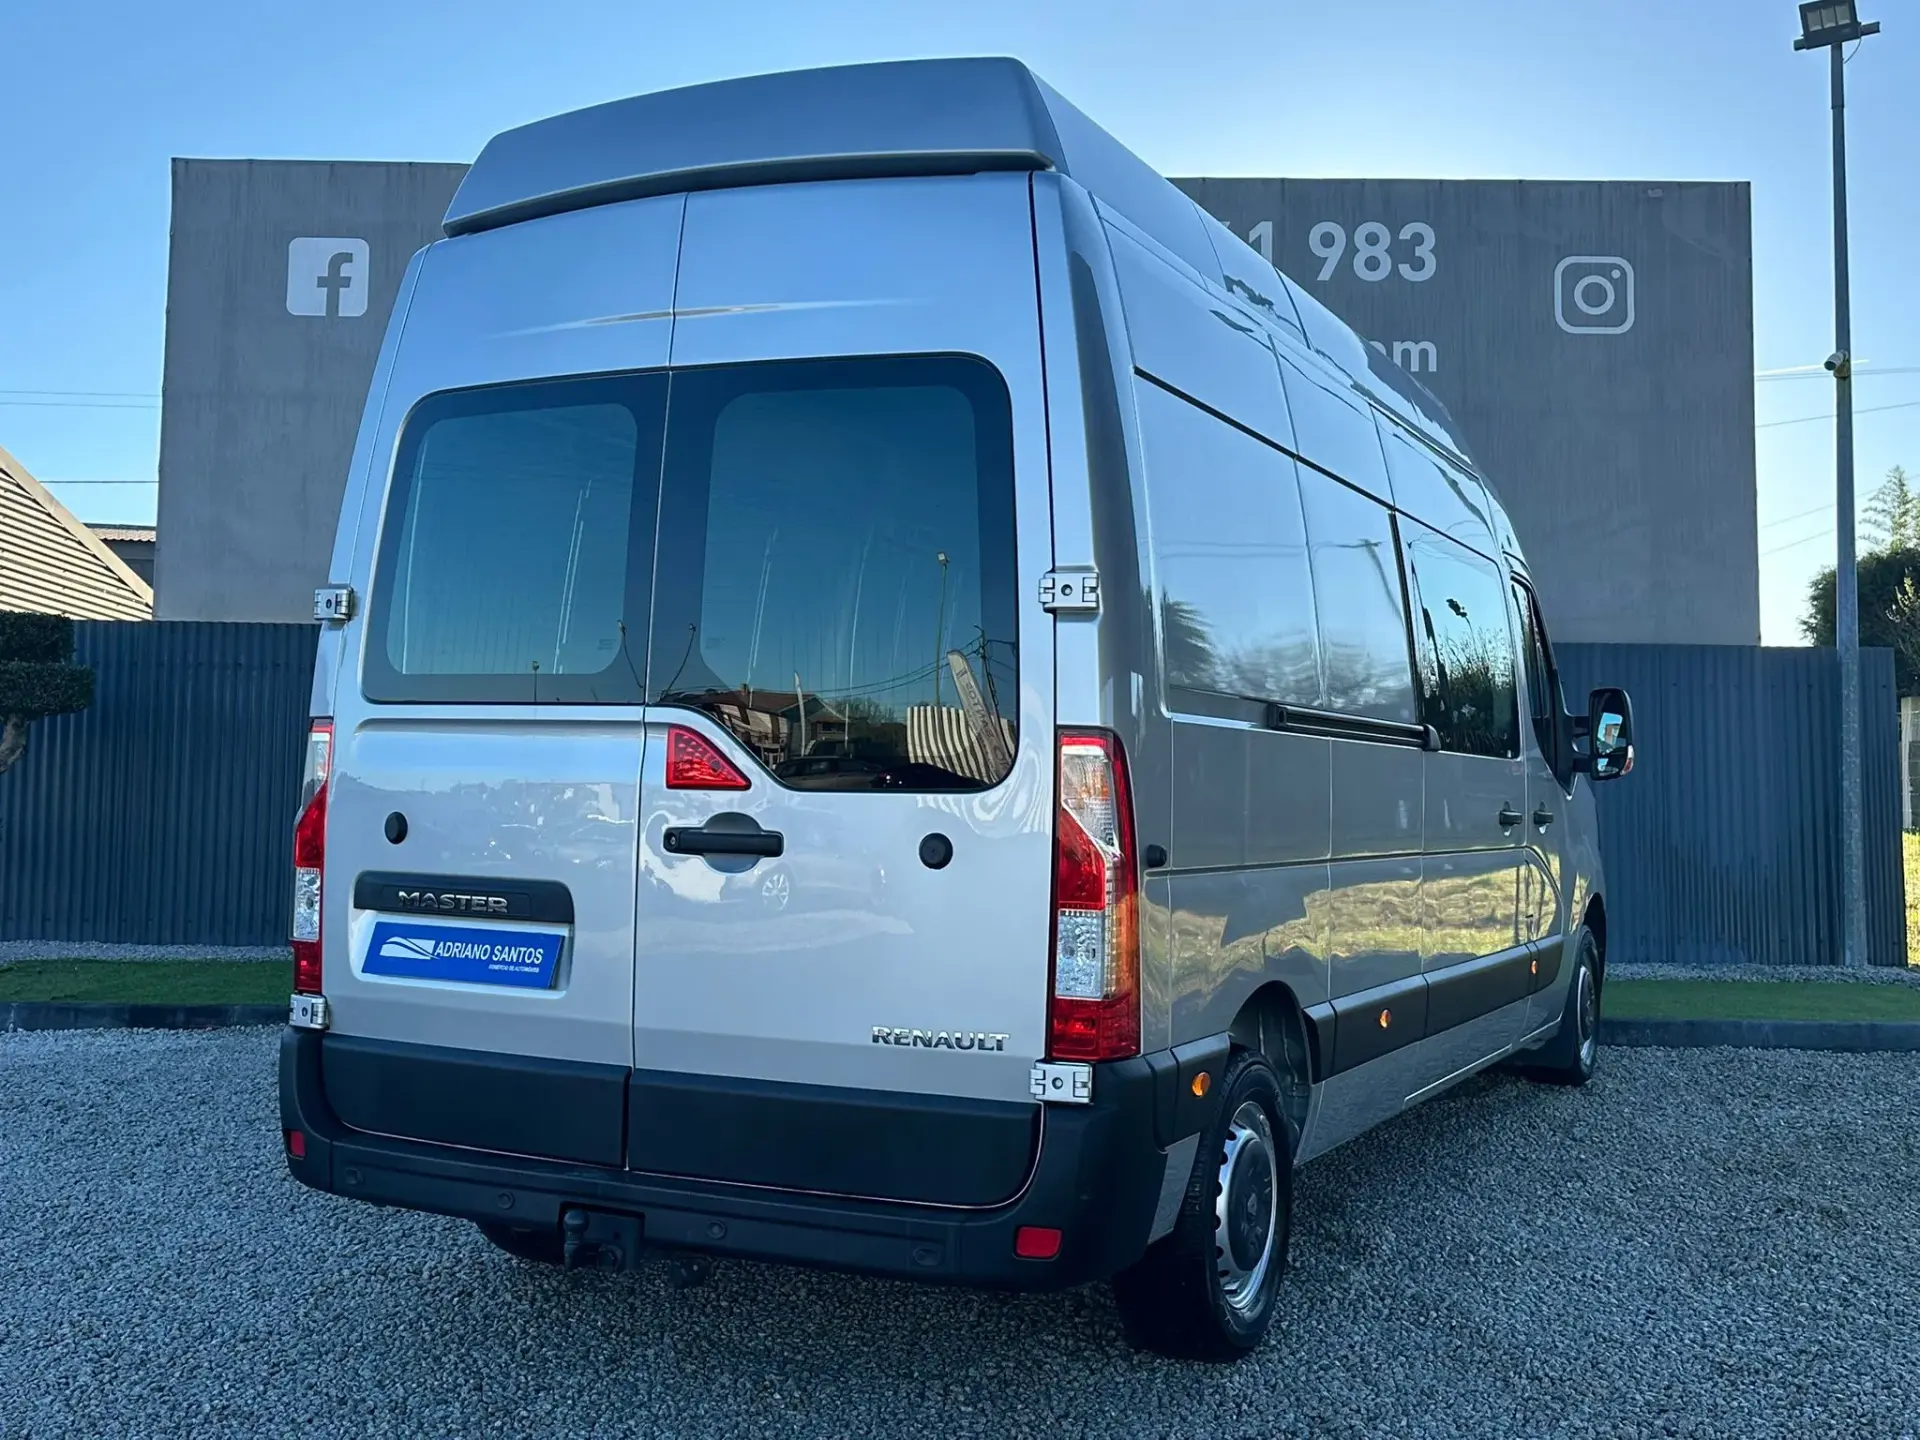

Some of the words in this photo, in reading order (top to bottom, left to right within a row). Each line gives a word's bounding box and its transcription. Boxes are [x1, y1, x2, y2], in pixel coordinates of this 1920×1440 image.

[1308, 221, 1437, 282] 983
[1369, 341, 1437, 372] m
[398, 890, 508, 913] MASTER
[434, 941, 491, 960] ADRIANO
[492, 946, 544, 964] SANTOS
[871, 1025, 1010, 1051] RENAULT
